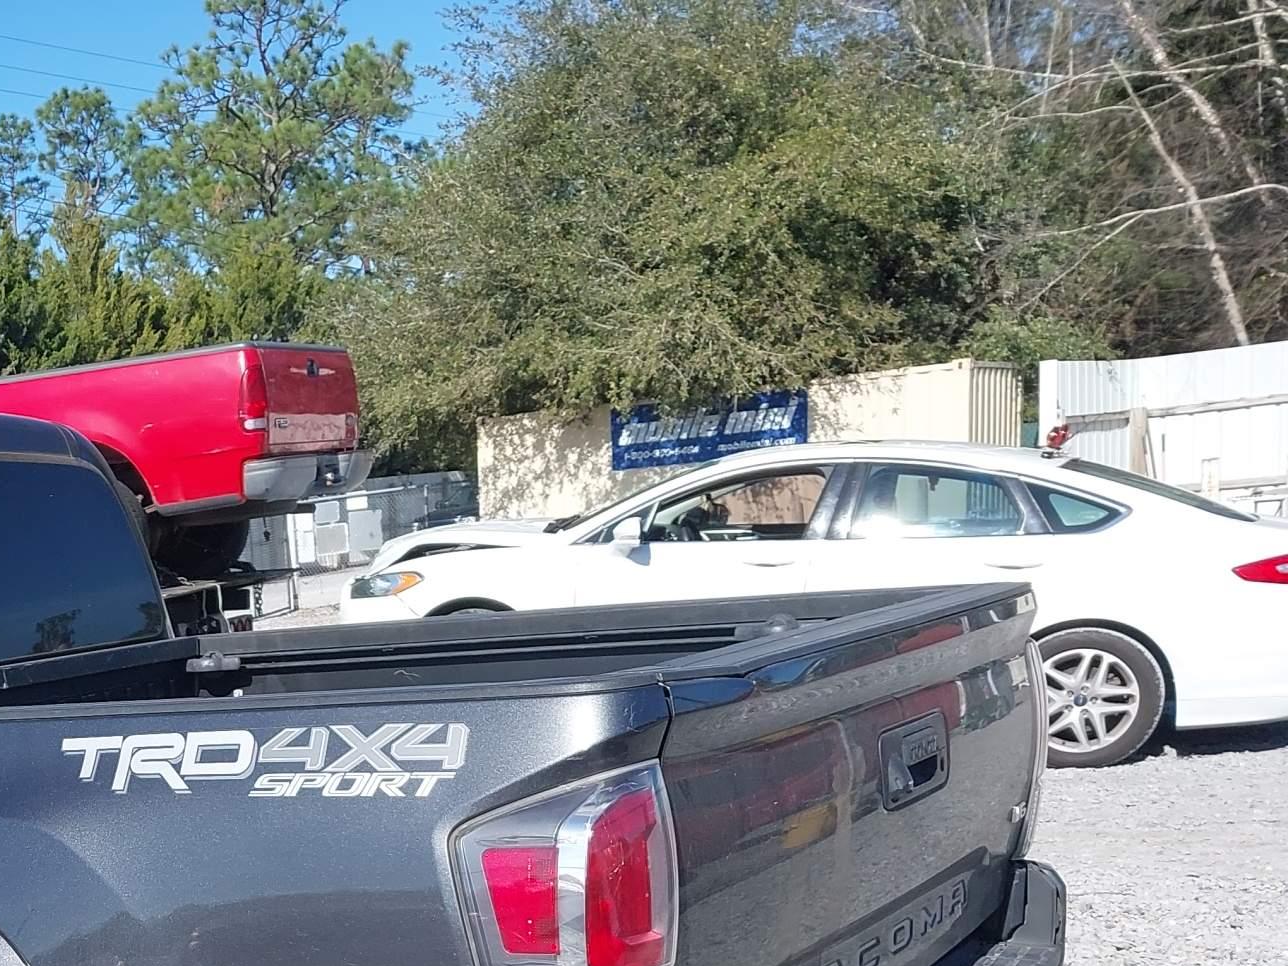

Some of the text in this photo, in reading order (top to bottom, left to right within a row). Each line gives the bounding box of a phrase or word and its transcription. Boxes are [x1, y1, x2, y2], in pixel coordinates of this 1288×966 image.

[618, 408, 721, 446] mobile
[62, 722, 471, 794] TRD 4X4
[248, 771, 457, 797] SPORT
